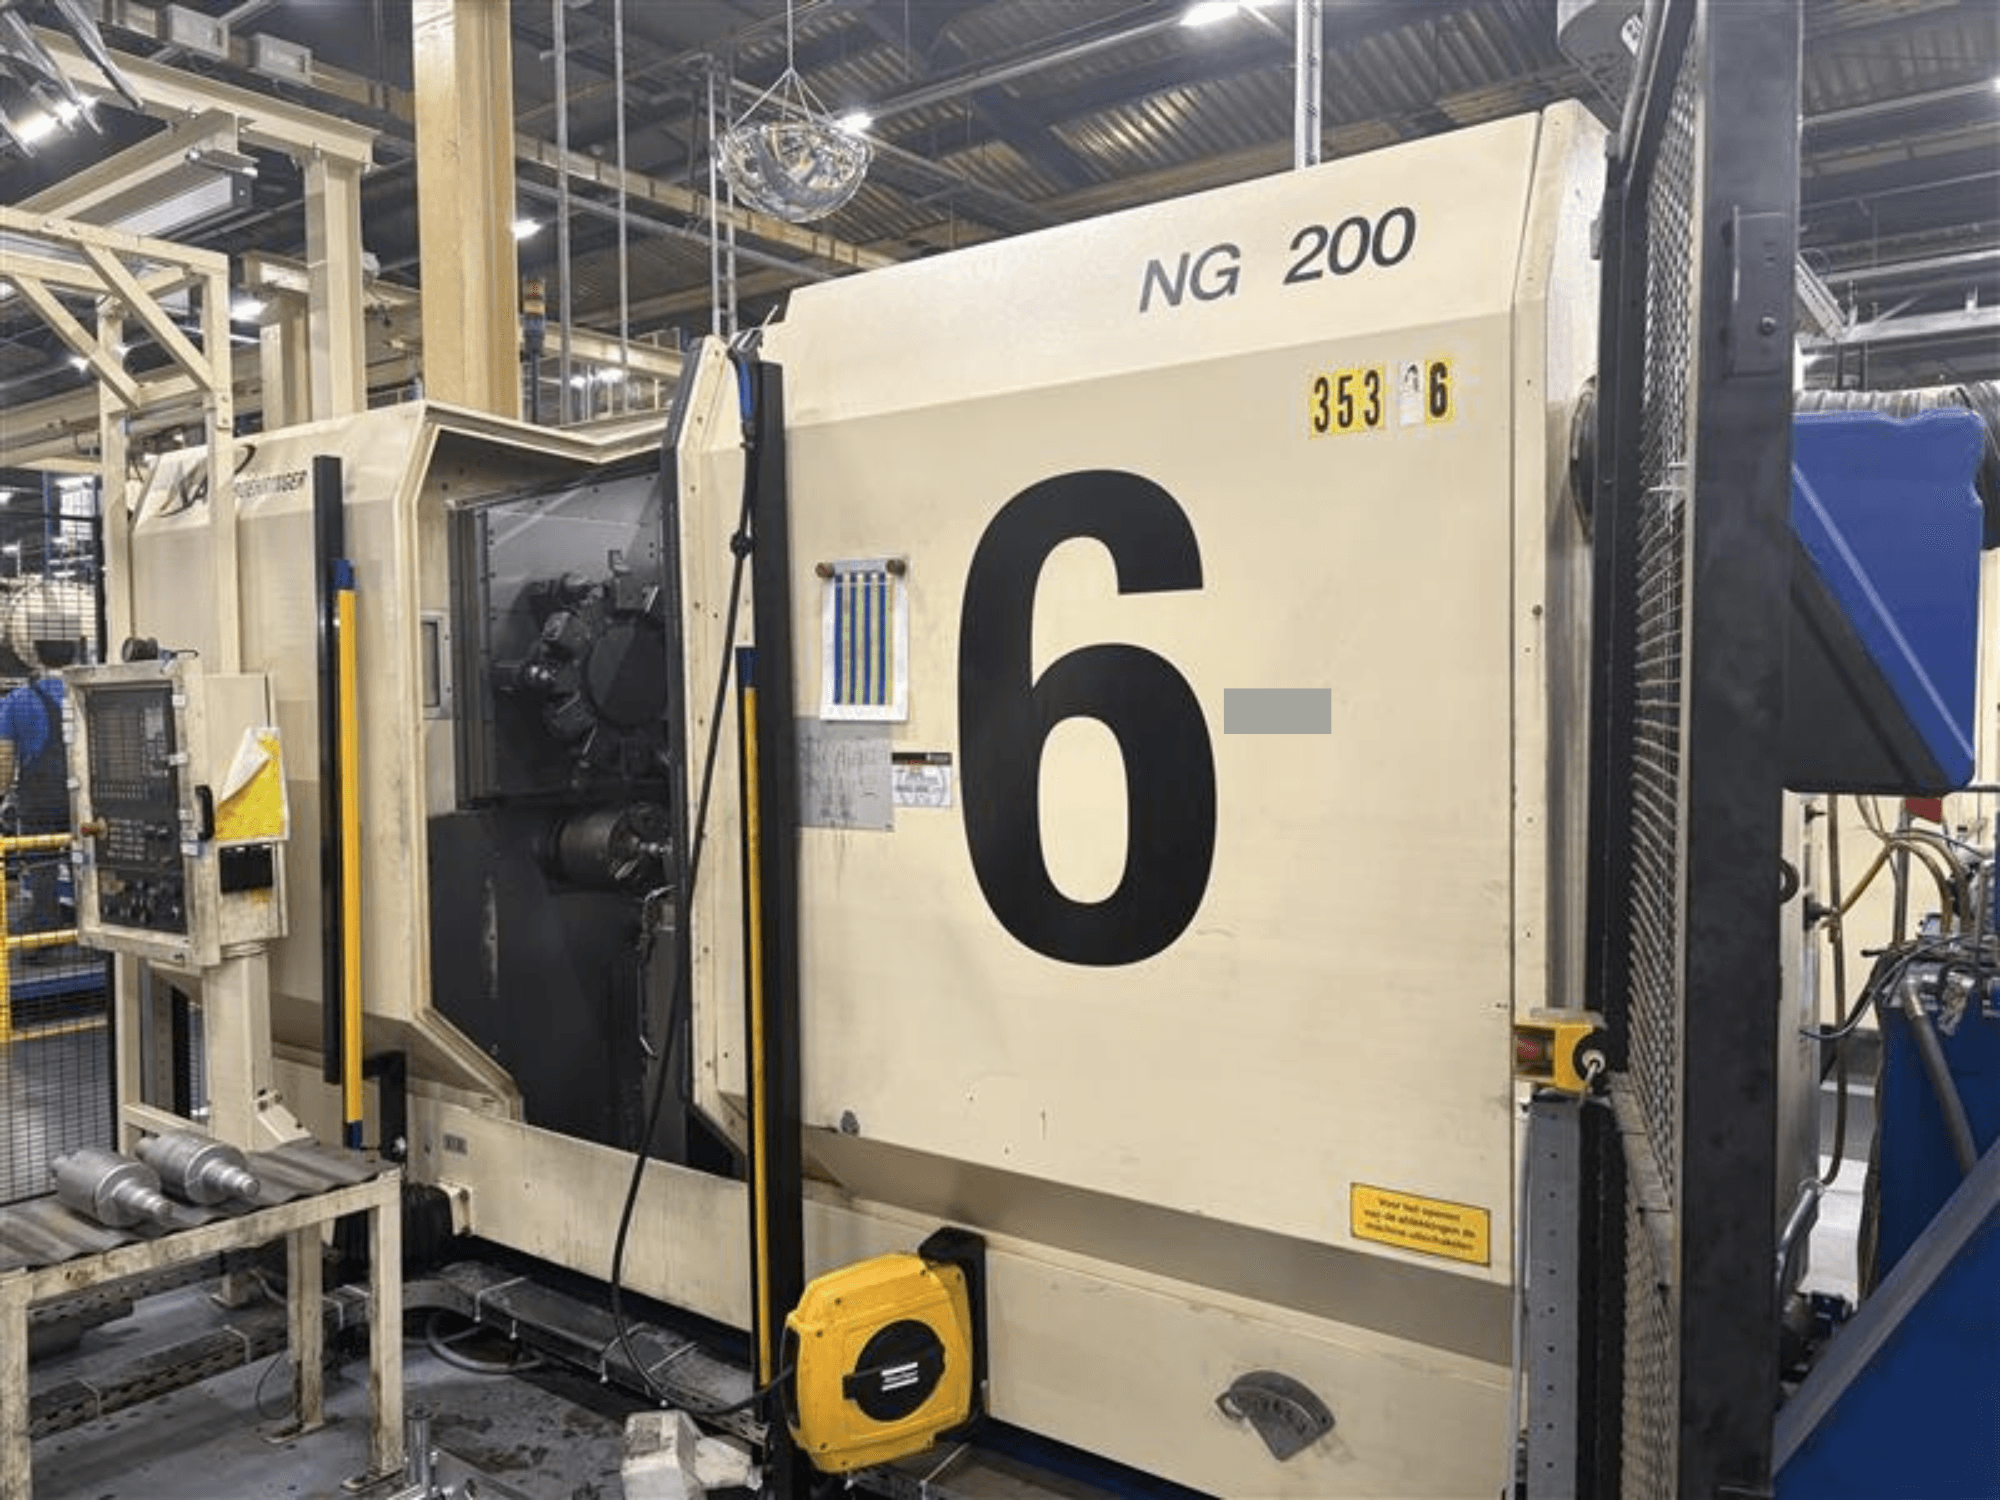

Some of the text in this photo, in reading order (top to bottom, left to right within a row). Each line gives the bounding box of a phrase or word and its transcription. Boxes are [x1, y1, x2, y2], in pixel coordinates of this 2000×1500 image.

[1139, 206, 1416, 313] NG 200
[1313, 368, 1381, 433] 353
[957, 469, 1217, 968] 6
